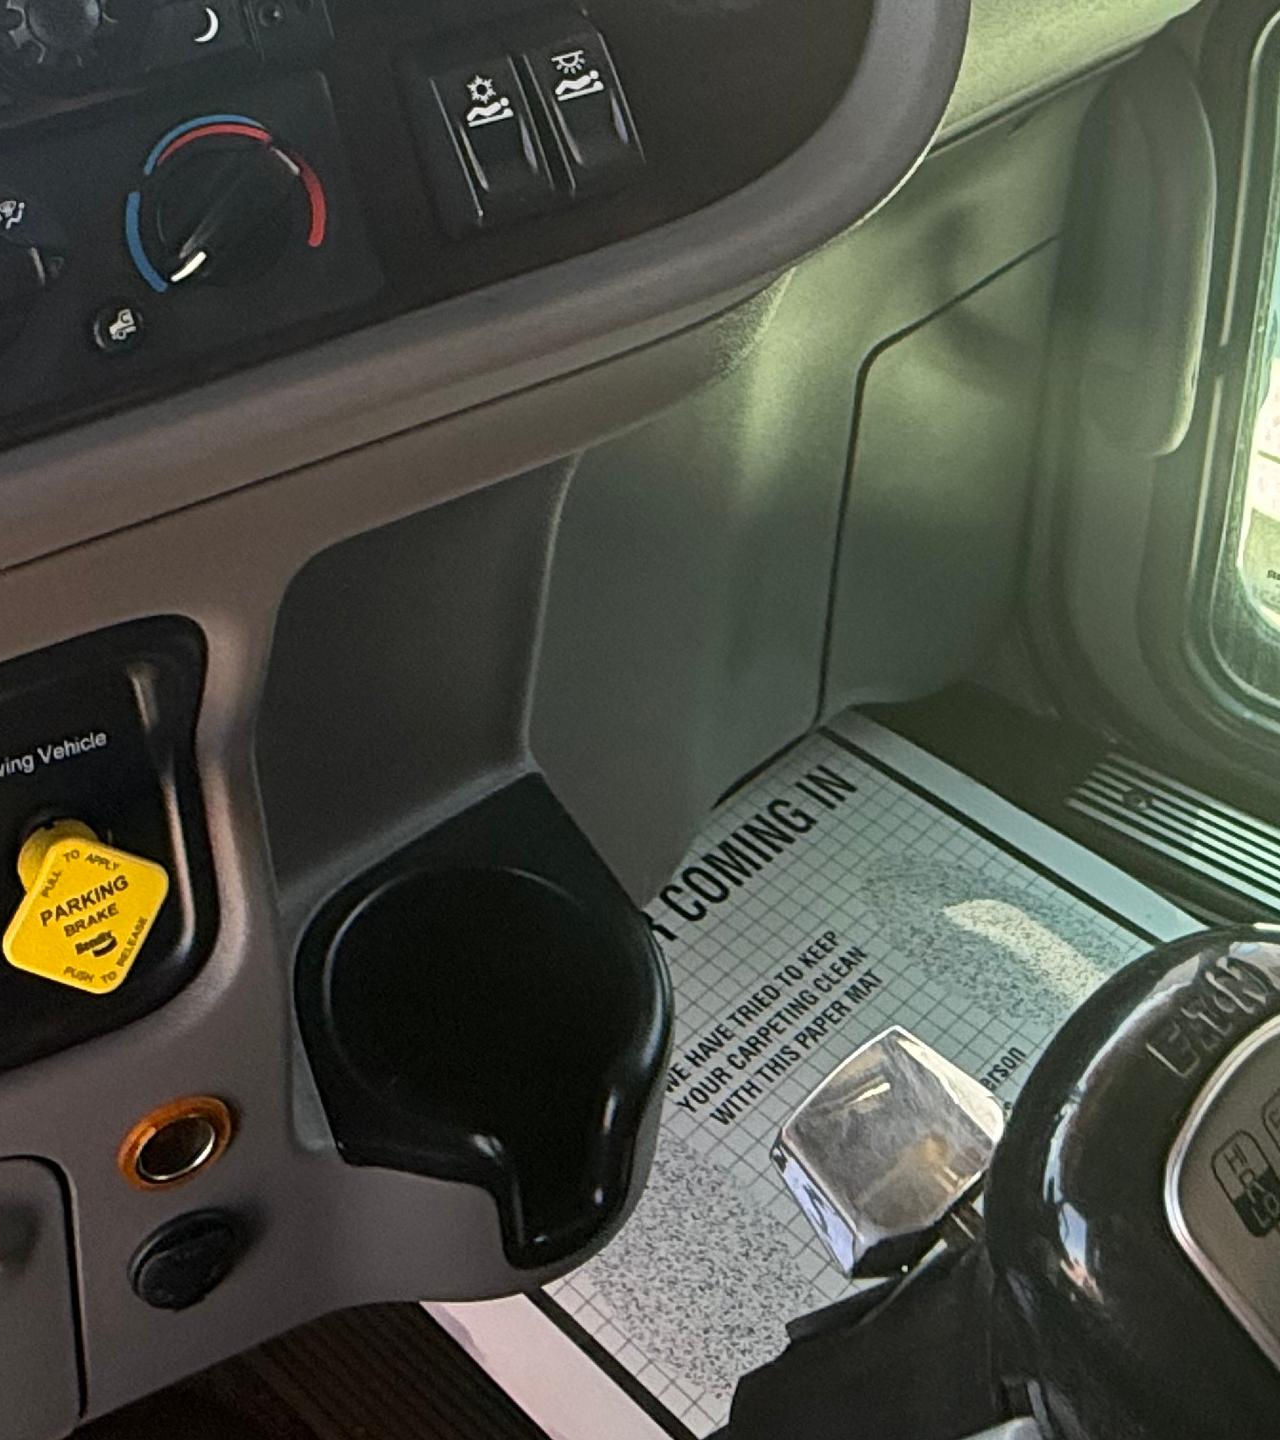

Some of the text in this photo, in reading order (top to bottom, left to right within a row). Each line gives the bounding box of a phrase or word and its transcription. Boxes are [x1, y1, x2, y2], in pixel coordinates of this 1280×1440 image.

[37, 729, 108, 765] Vehicle
[62, 849, 81, 863] TO
[659, 764, 859, 922] COMING IN
[38, 874, 130, 927] PARKING
[63, 903, 120, 938] BRAKE
[100, 971, 118, 985] TO
[115, 916, 149, 968] RELEASE
[664, 930, 841, 1094] WE HAVE TRIED TO KEEP
[676, 945, 869, 1114] YOUR CARPETING CLEAN
[709, 968, 884, 1127] WITH THIS PAPER MAT
[979, 1046, 1027, 1092] erson
